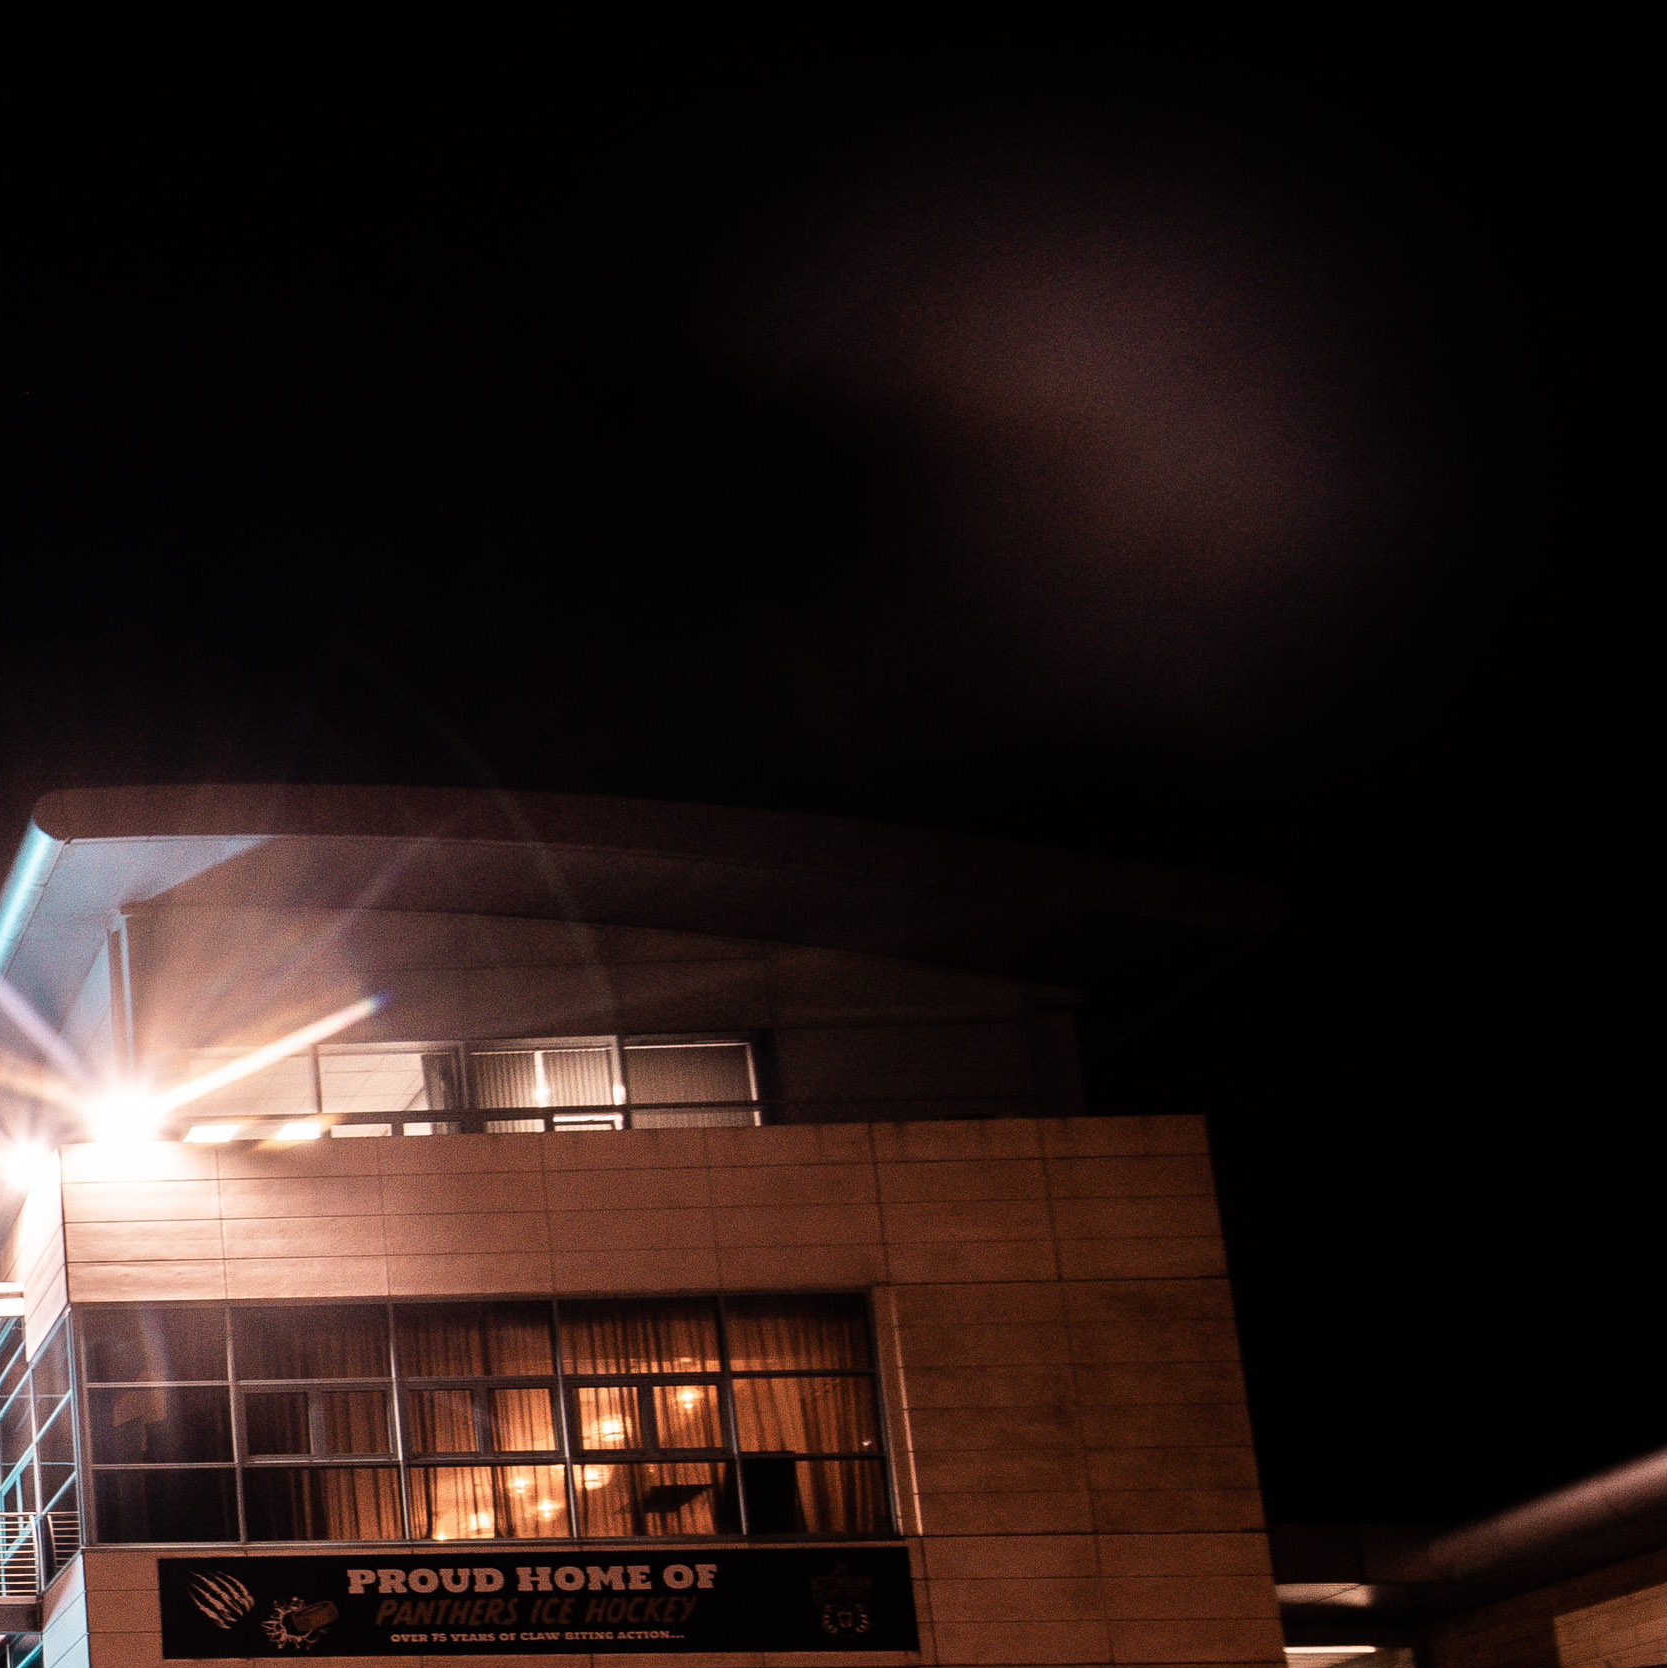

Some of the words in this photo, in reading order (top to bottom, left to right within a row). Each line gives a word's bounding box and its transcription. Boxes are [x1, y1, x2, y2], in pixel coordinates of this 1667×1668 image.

[346, 1567, 505, 1594] PROUD
[515, 1565, 653, 1592] HOME
[662, 1563, 718, 1589] OF
[375, 1598, 519, 1627] PANTHERS
[529, 1597, 576, 1624] ICE
[584, 1595, 698, 1623] HOCKEY
[390, 1633, 428, 1642] OVER
[431, 1633, 447, 1642] 75
[450, 1632, 496, 1641] YEARS
[499, 1632, 517, 1641] OF
